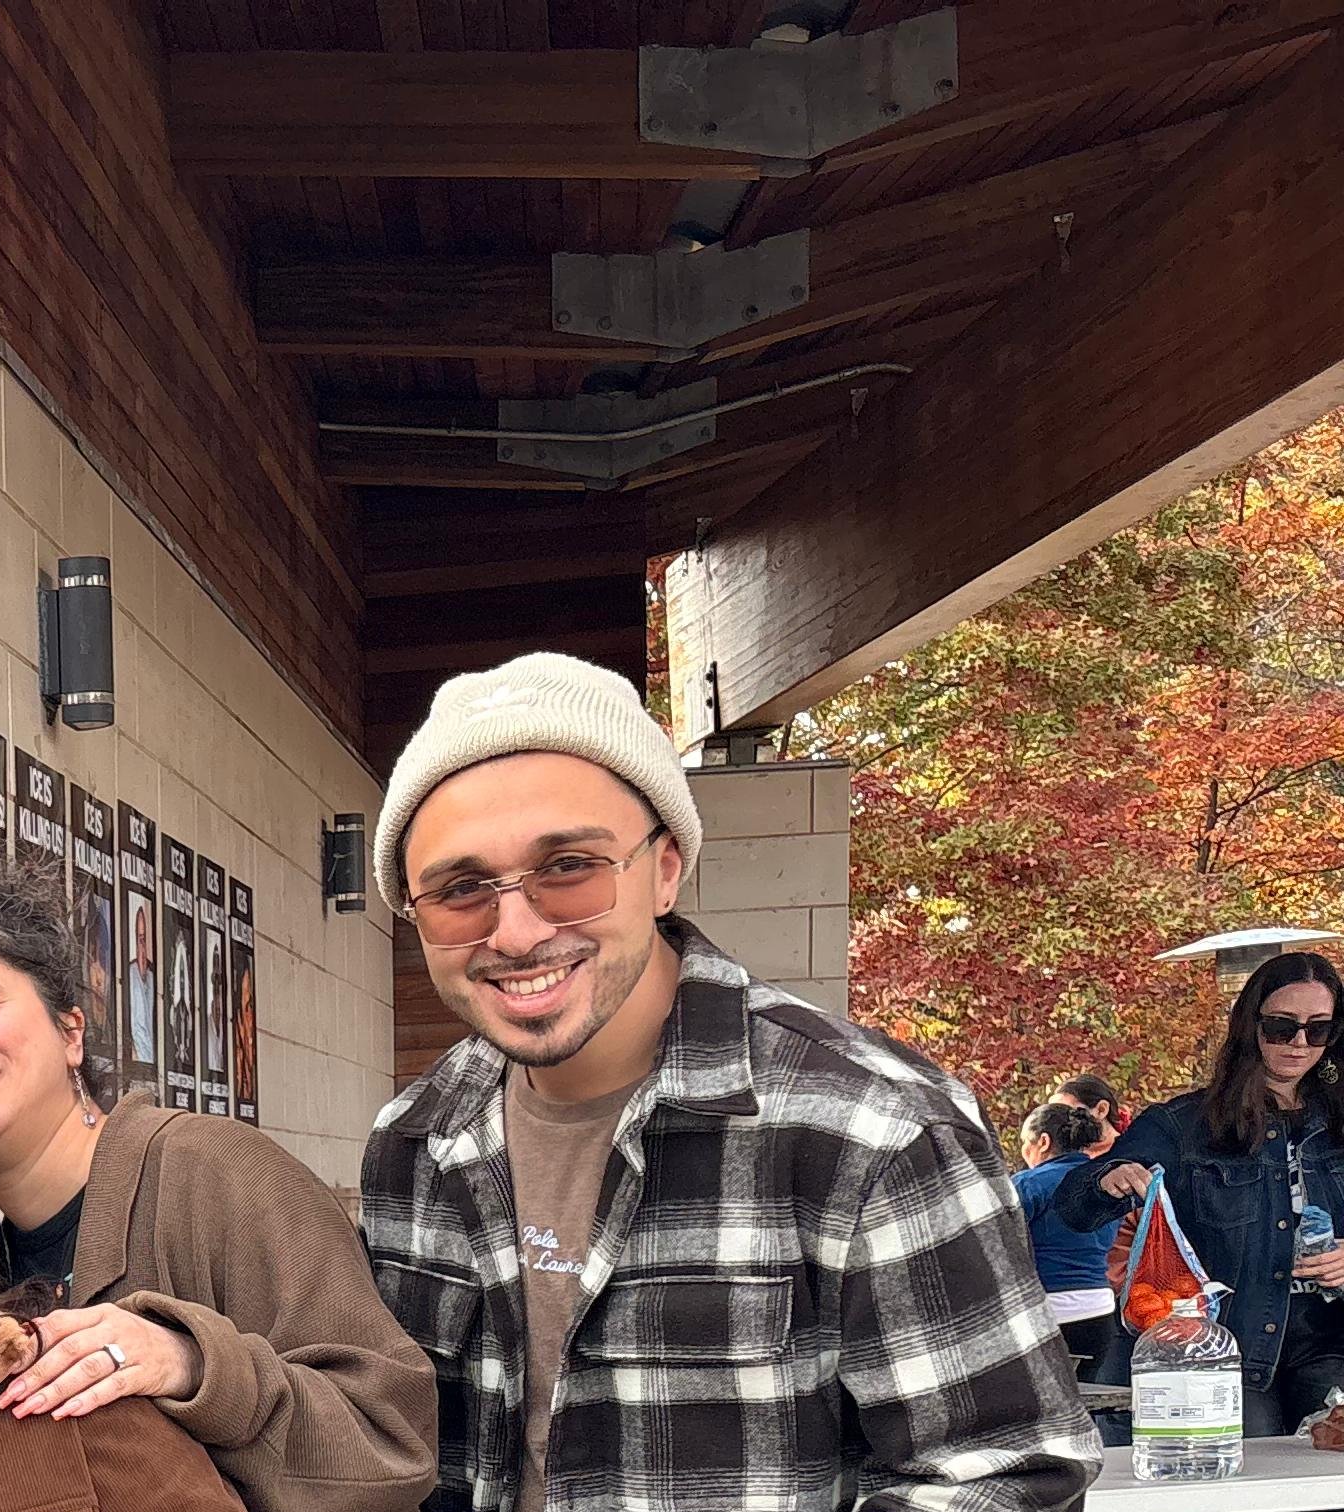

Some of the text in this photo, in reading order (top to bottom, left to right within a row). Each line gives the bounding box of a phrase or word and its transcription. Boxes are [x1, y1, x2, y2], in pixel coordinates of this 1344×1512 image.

[28, 765, 53, 808] ICE IS
[18, 805, 51, 850] KILLING
[521, 1225, 560, 1249] Polo
